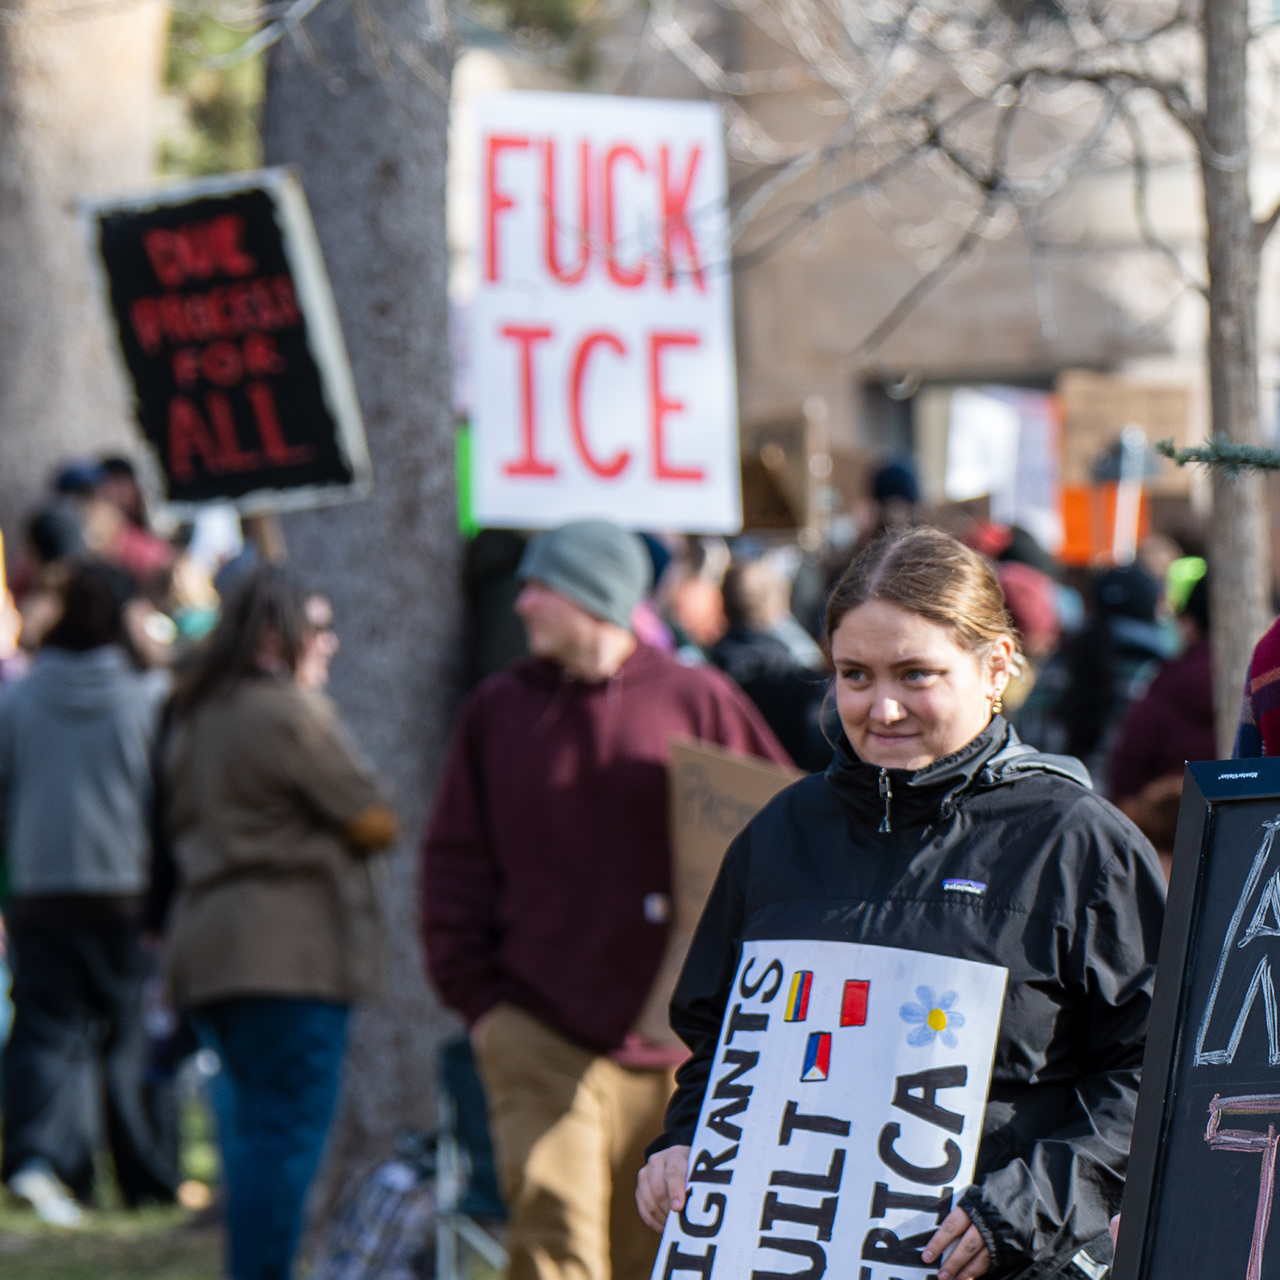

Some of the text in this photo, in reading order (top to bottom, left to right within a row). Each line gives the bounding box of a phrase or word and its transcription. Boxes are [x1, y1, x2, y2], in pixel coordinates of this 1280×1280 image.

[143, 212, 256, 288] DUE
[483, 133, 706, 295] FUCK
[172, 333, 285, 390] FOR
[498, 325, 707, 481] ICE
[169, 380, 317, 482] ALL
